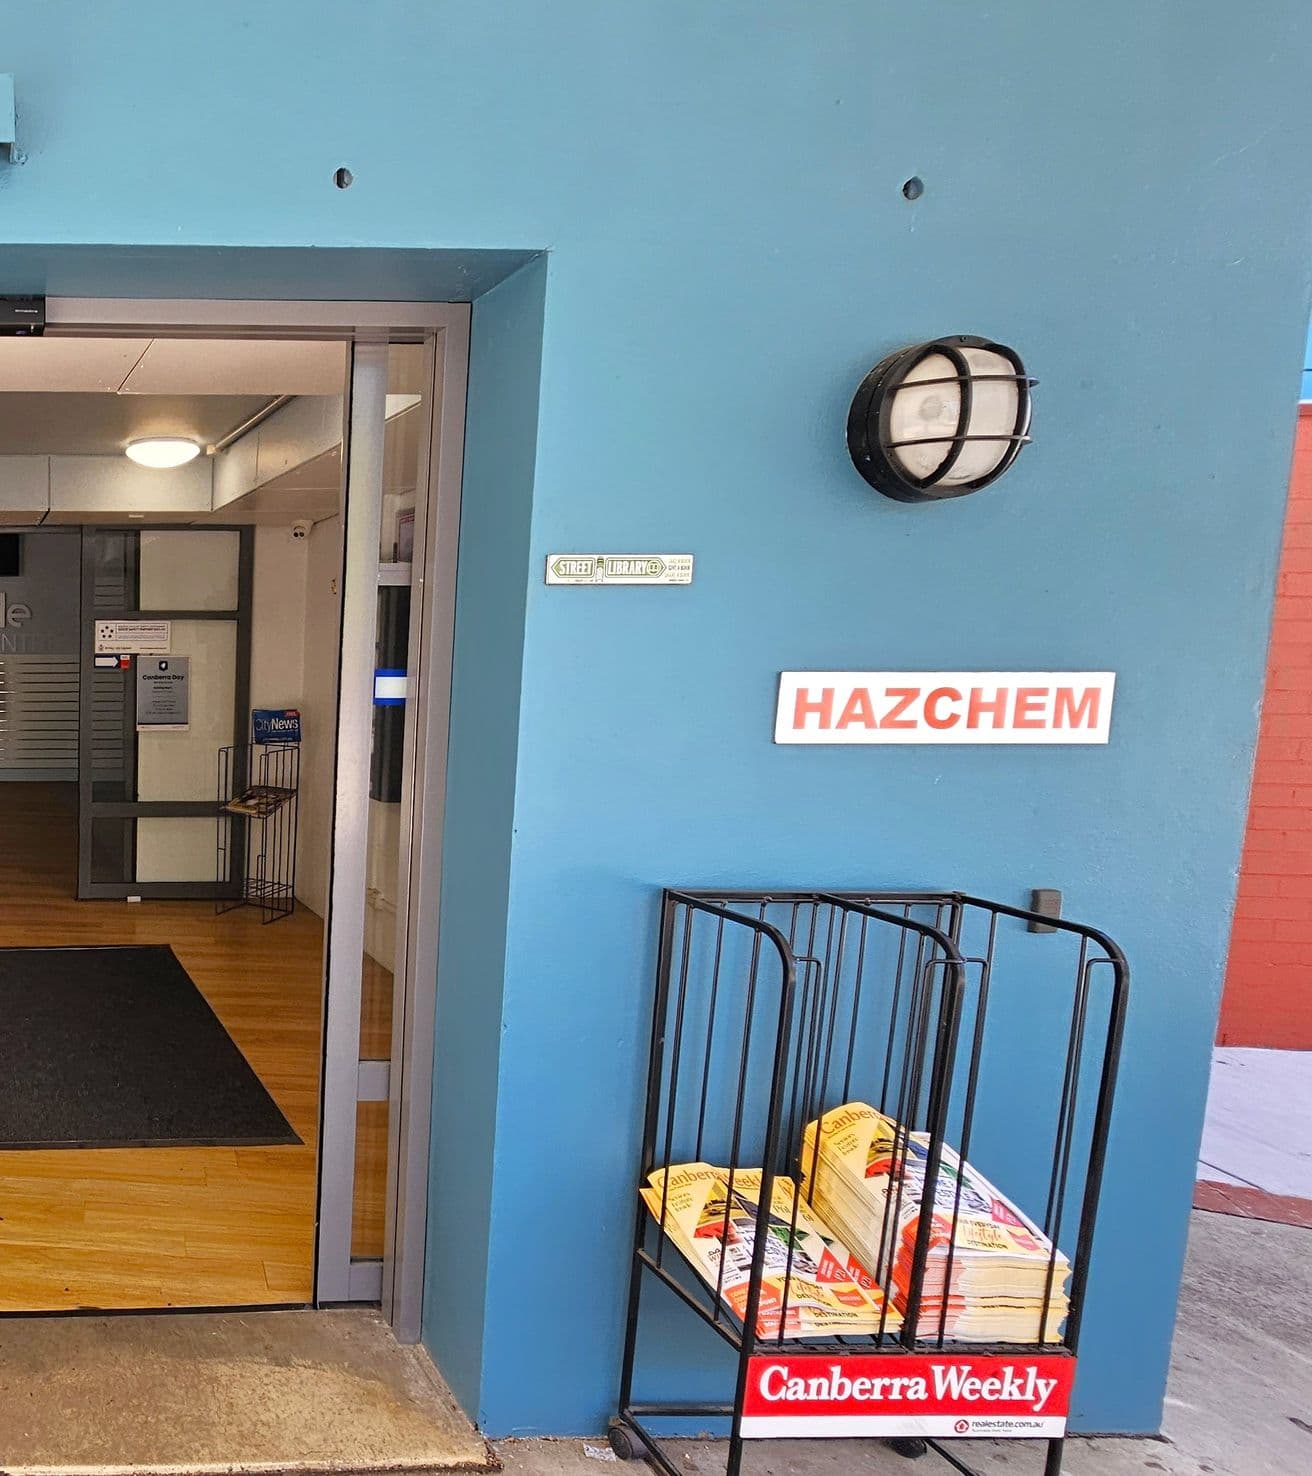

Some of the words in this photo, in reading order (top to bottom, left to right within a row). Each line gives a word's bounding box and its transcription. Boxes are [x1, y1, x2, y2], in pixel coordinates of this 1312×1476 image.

[558, 559, 594, 576] STREET
[607, 559, 649, 576] LIBRARY
[791, 686, 1102, 730] HAZCHEM
[759, 1365, 929, 1402] Canberra
[930, 1365, 1058, 1412] Weekly
